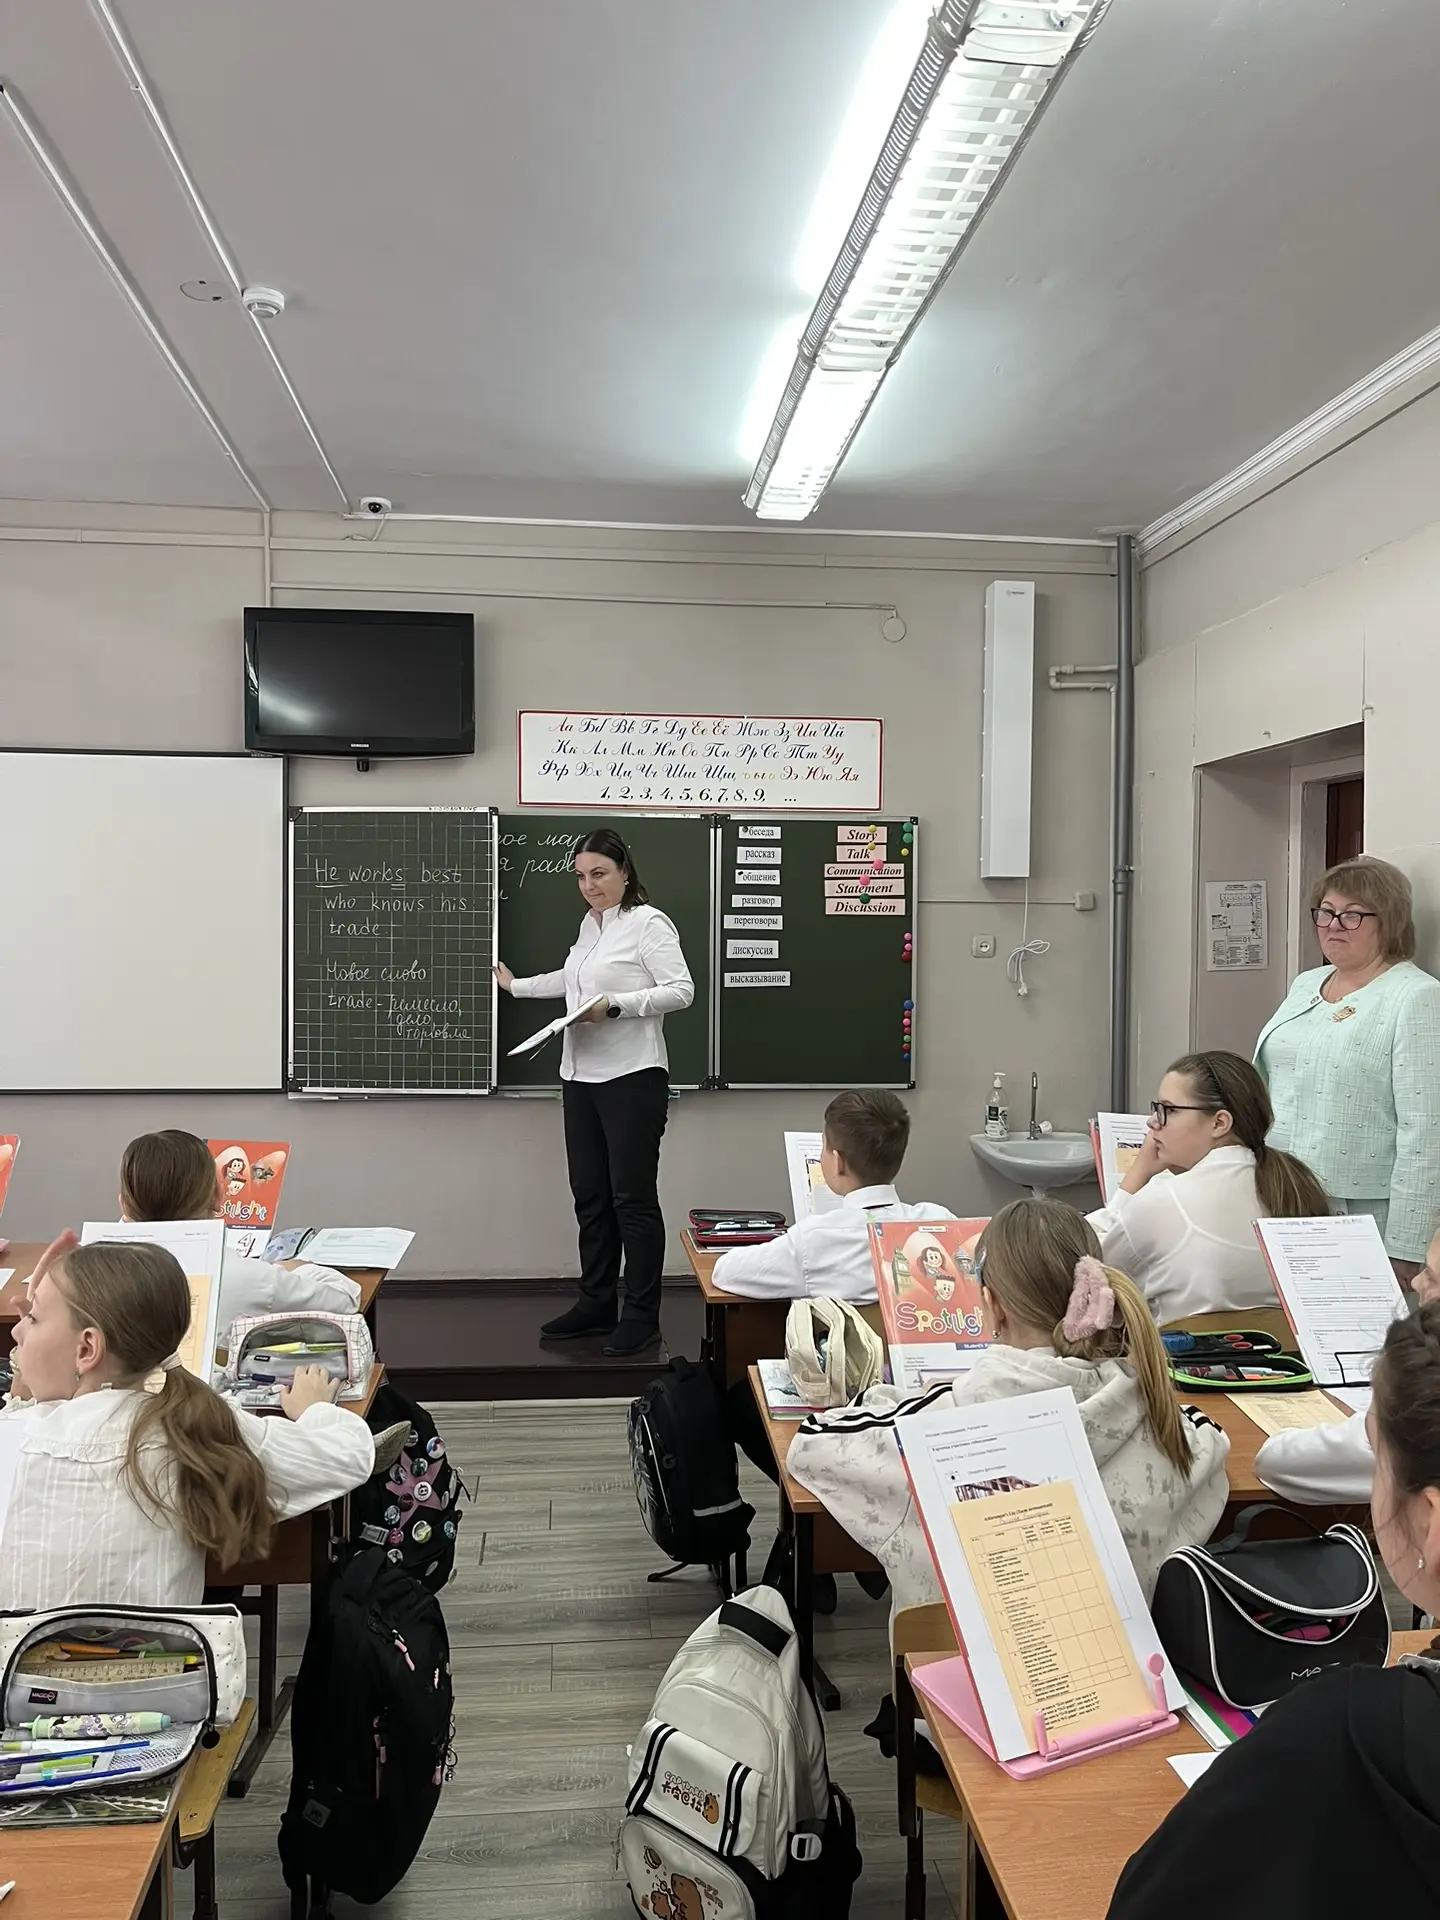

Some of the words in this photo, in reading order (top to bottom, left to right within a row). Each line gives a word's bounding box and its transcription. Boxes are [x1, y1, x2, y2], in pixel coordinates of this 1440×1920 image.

[549, 717, 573, 732] Аа
[578, 717, 611, 733] Бб
[609, 719, 635, 734] Вв
[638, 719, 660, 735] Гг
[664, 719, 687, 741] Дд
[691, 721, 708, 736] Ее
[712, 719, 729, 736] Ёё
[732, 721, 769, 737] Жж
[773, 721, 791, 743] Зз
[793, 722, 818, 738] Ии
[819, 721, 845, 738] Йй
[551, 739, 578, 754] Кк
[582, 740, 607, 755] Лл
[611, 741, 645, 756] Мм
[650, 741, 678, 757] Нн
[681, 742, 698, 757] Оо
[701, 742, 731, 758] Пп
[734, 743, 758, 765] Рр
[761, 743, 780, 759] Сс
[783, 743, 818, 759] Тт
[821, 744, 845, 765] Уу
[537, 759, 569, 781] Фф
[574, 761, 602, 777] Хх
[606, 761, 632, 780] Цц
[636, 762, 658, 778] Чч
[662, 762, 697, 779] Шш
[701, 763, 737, 782] Щщ
[780, 765, 799, 781] Ээ
[801, 765, 833, 781] Юю
[835, 766, 860, 782] Яя
[600, 786, 611, 800] 1,
[618, 786, 634, 801] 2,
[639, 786, 653, 801] 3,
[659, 787, 674, 801] 4,
[679, 788, 693, 801] 5,
[699, 788, 713, 802] 6,
[717, 788, 729, 803] 7,
[733, 788, 748, 802] 8,
[748, 826, 774, 837] беседа
[847, 829, 878, 843] Story
[745, 849, 775, 861] рассказ
[847, 848, 871, 859] Talk
[315, 858, 340, 882] He
[349, 861, 403, 882] works
[421, 861, 462, 883] best
[742, 871, 777, 882] общение
[826, 866, 902, 876] Communication
[836, 883, 893, 894] Statement
[325, 892, 357, 909] who
[371, 891, 425, 912] knows
[440, 891, 468, 913] his
[741, 897, 776, 907] разговор
[834, 901, 896, 912] Discussion
[733, 917, 778, 927] переговоры
[732, 946, 774, 958] дискуссия
[327, 958, 372, 980] Новое
[730, 974, 786, 984] высказывание
[895, 1301, 984, 1337] Spotlig
